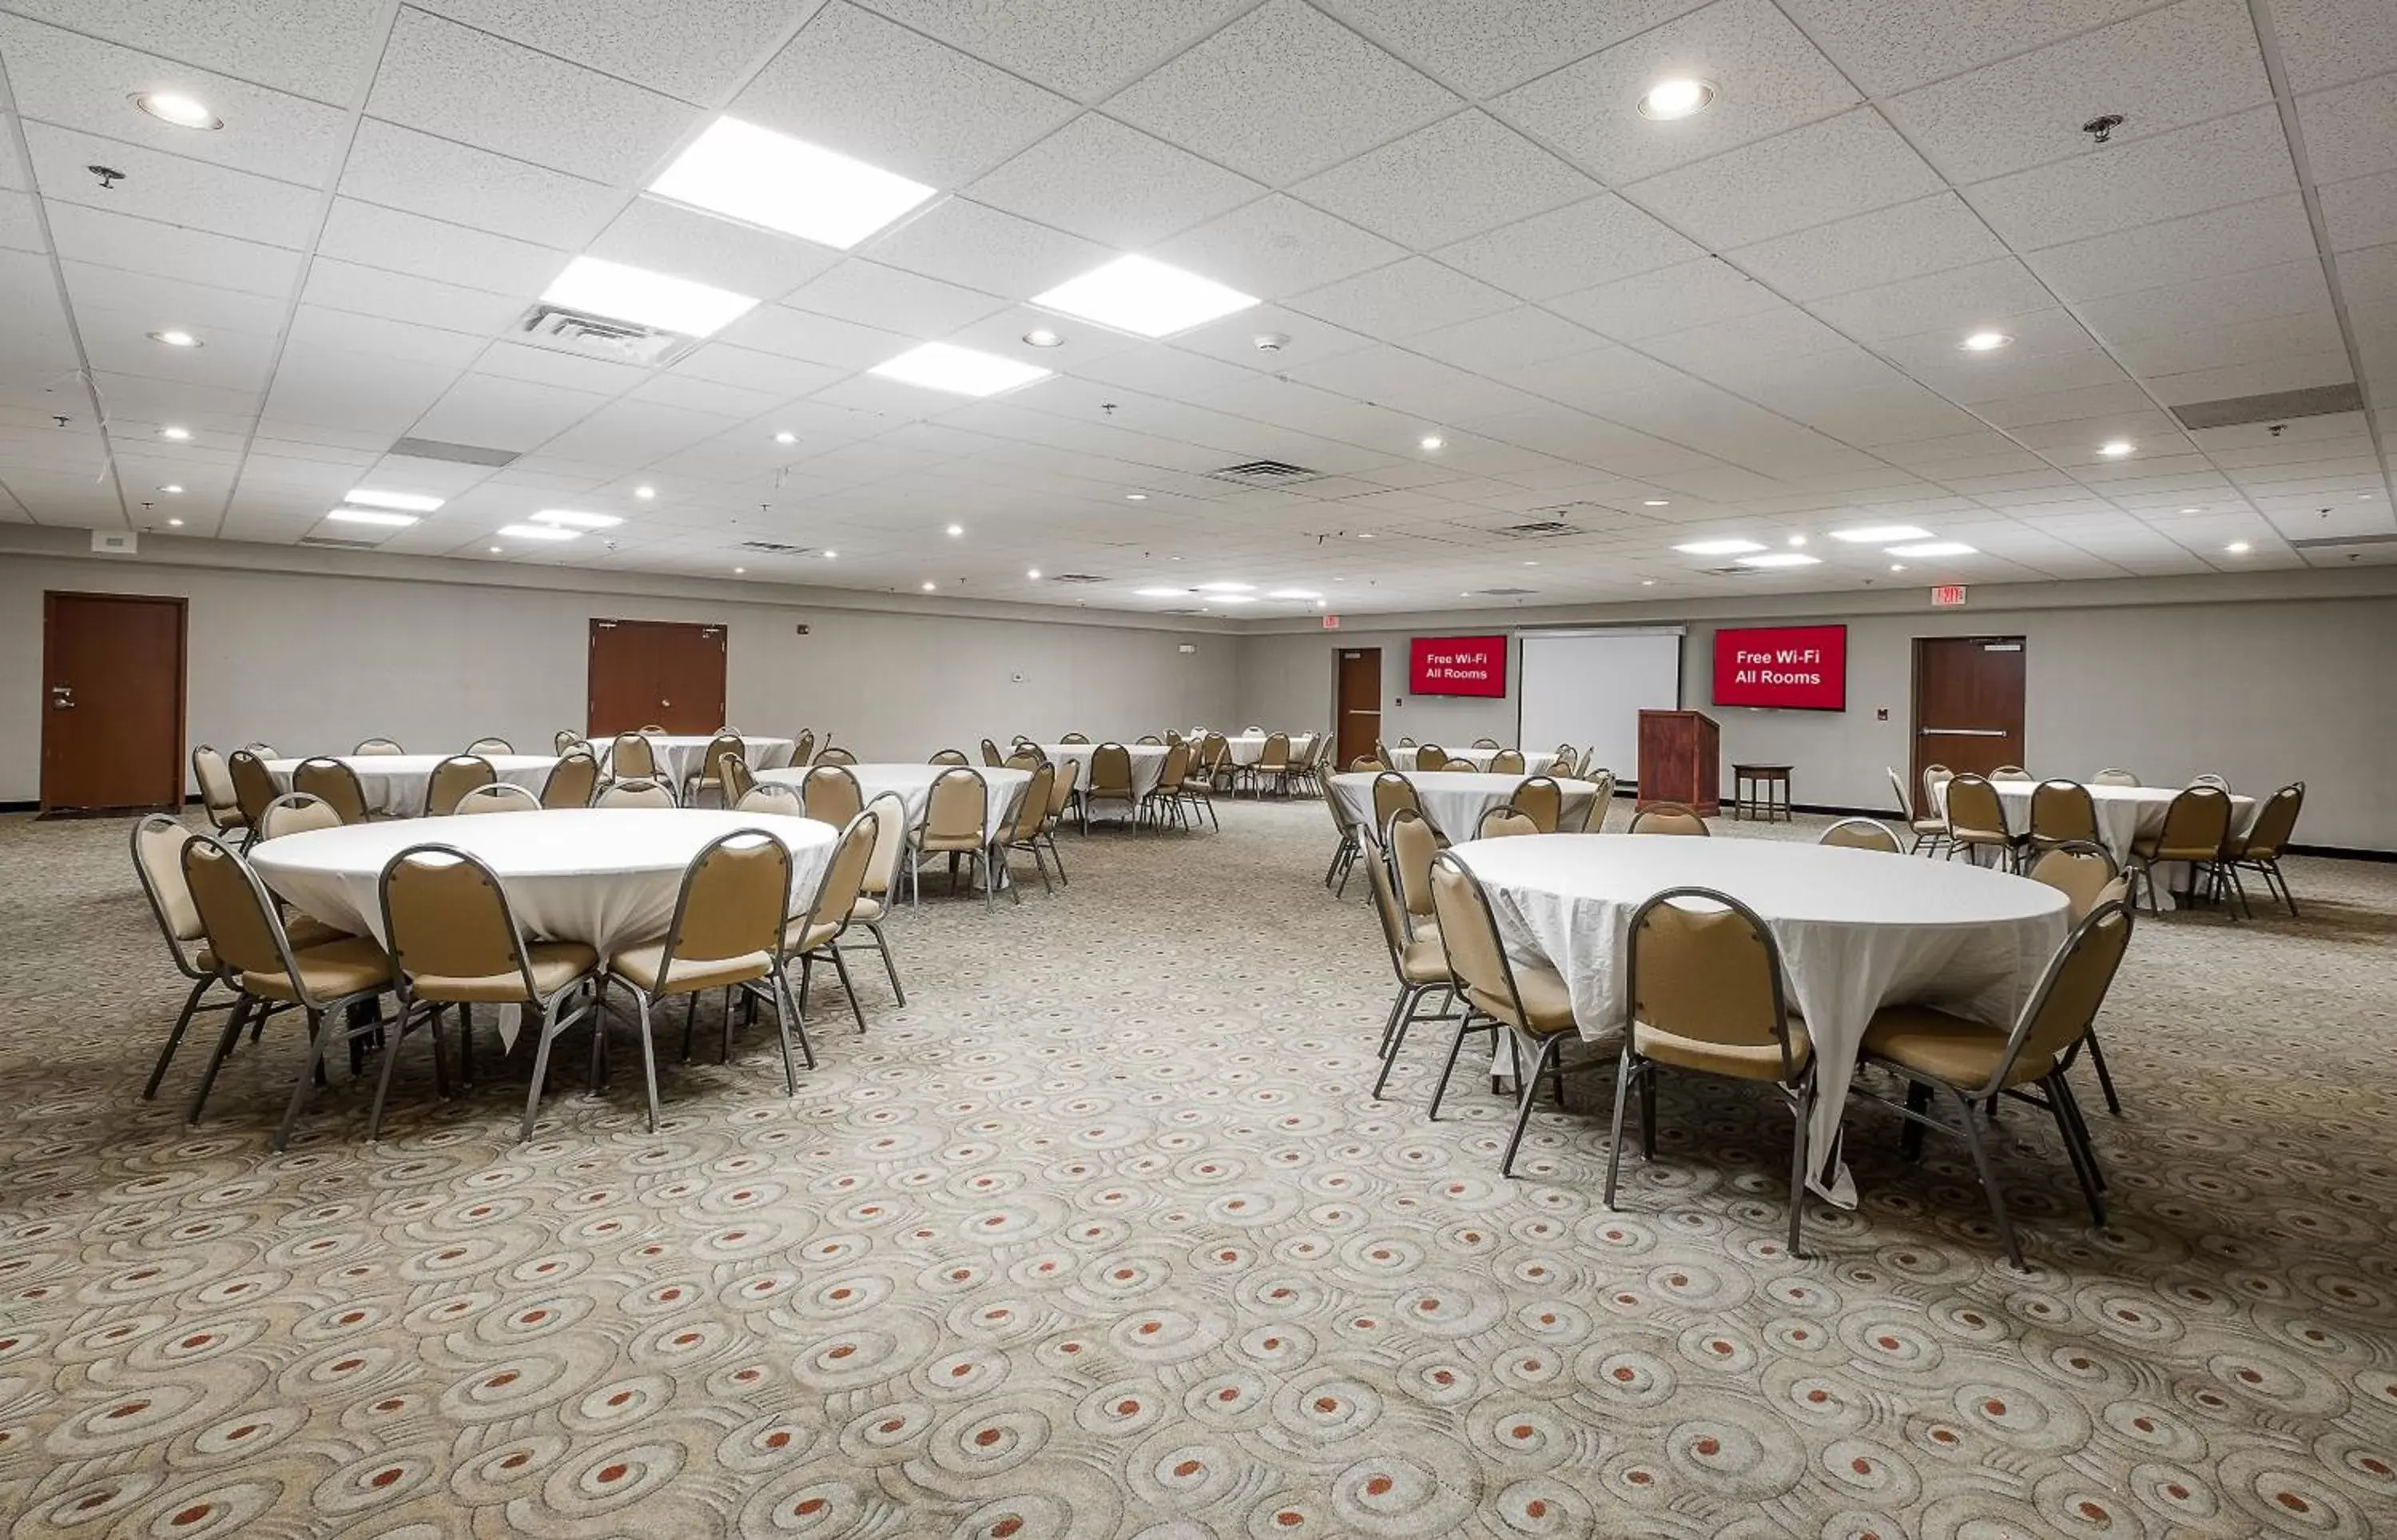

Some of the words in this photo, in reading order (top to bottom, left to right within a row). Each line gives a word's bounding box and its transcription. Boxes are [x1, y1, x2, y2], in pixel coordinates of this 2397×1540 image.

[1426, 653, 1452, 664] Free
[1455, 653, 1487, 664] Wi-Fi
[1736, 651, 1771, 664] Free
[1776, 649, 1820, 664] Wi-Fi
[1425, 668, 1441, 678] All
[1444, 669, 1488, 680] Rooms
[1735, 670, 1756, 684] All
[1761, 670, 1821, 685] Rooms
